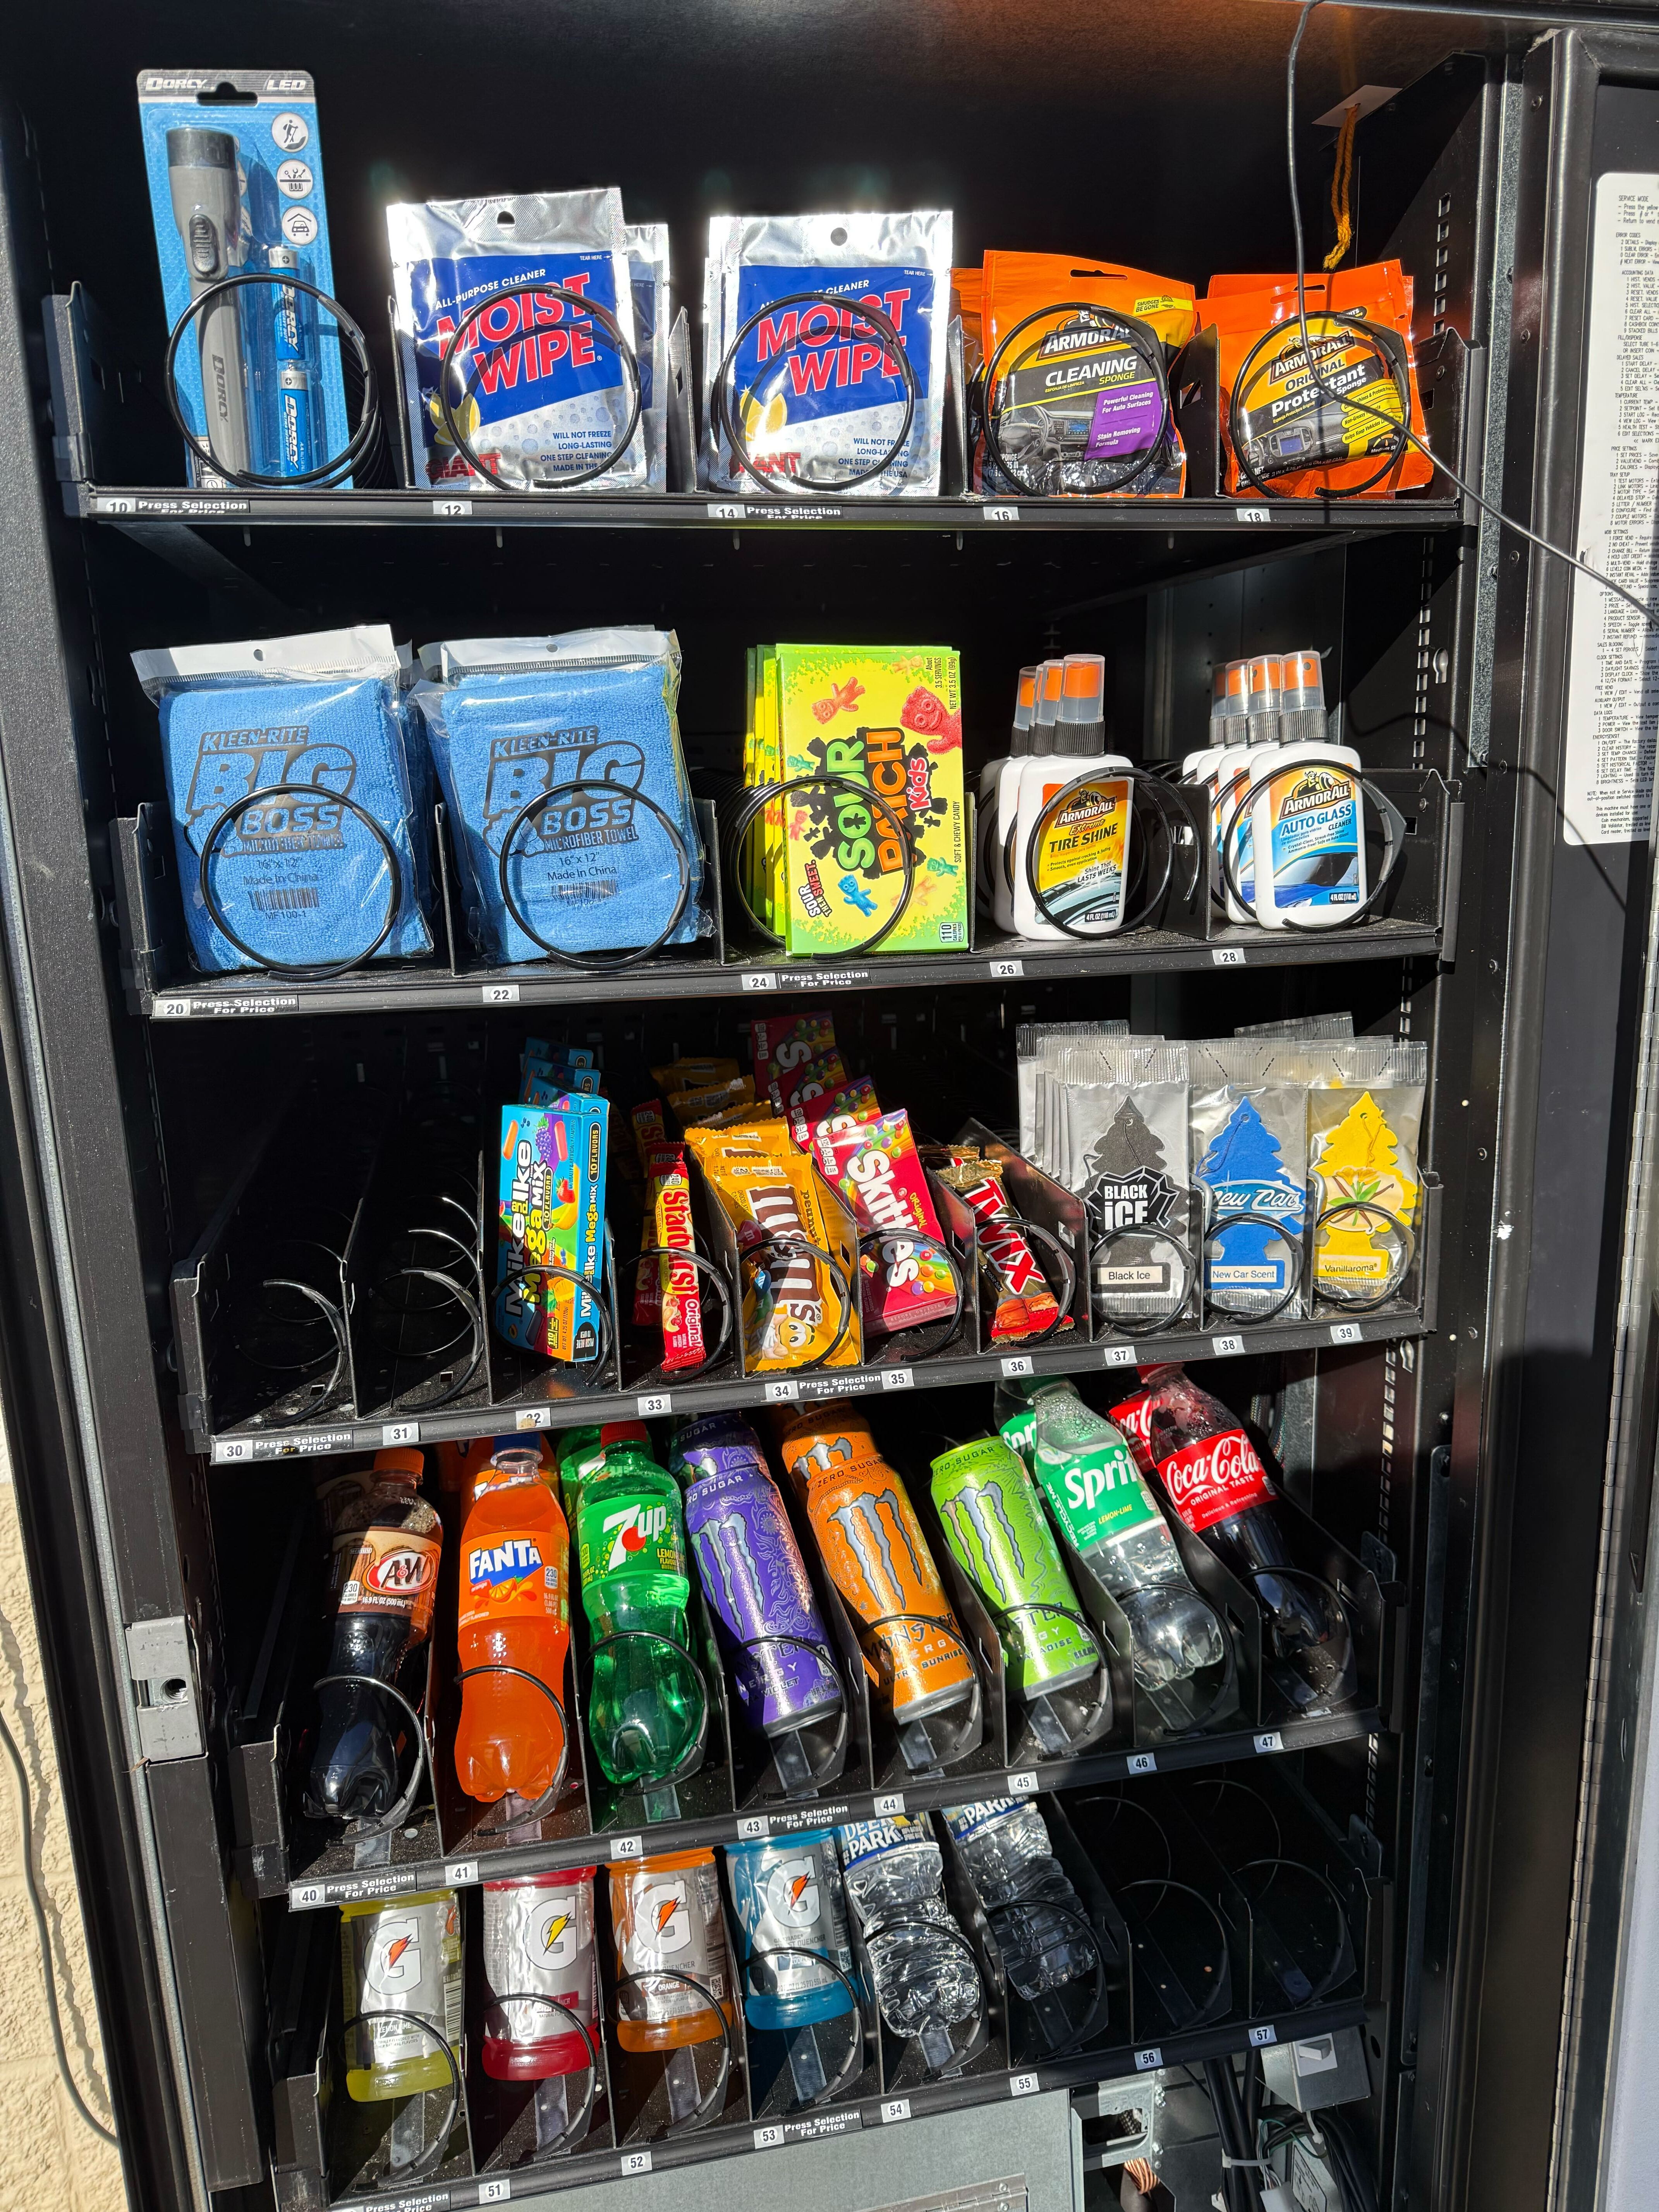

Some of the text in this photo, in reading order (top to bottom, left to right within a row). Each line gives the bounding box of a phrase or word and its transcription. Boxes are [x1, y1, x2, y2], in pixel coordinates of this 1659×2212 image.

[145, 77, 305, 91] DORCY LED
[435, 268, 546, 309] ALL-PURPOSE CLEANER
[1137, 300, 1160, 308] SMUDGES
[1142, 303, 1159, 311] GONE
[436, 272, 590, 361] MOIST
[757, 288, 911, 362] MOIST
[473, 321, 595, 395] WIPE
[1045, 356, 1137, 387] CLEANING
[1099, 371, 1135, 385] SPONGE
[212, 354, 228, 423] DORCY
[1336, 376, 1367, 394] Sponge
[1104, 391, 1153, 405] Powerful Cleaning
[1113, 402, 1126, 410] Auto
[1127, 399, 1151, 409] Surfaces
[285, 394, 299, 472] DORCY
[1097, 427, 1140, 441] Stain Removing
[558, 441, 612, 450] LONG-LASTING
[1096, 439, 1118, 447] Formula
[110, 502, 127, 512] 10
[445, 505, 461, 514] 12
[720, 509, 735, 517] 14
[995, 510, 1009, 520] 16
[1247, 512, 1260, 521] 18
[203, 726, 308, 752] KLEEN-RITE
[495, 727, 598, 757] KLEEN-RITE
[190, 744, 356, 813] BIG
[485, 742, 645, 819] BIG
[907, 757, 930, 811] Kids
[828, 739, 874, 872] SOUR
[240, 805, 341, 836] BOSS
[541, 800, 632, 835] BOSS
[1281, 805, 1352, 836] AUTO GLASS
[1328, 818, 1352, 831] CLEANER
[544, 825, 639, 853] MICROFIBER TOWEL
[1050, 823, 1118, 852] TIRE SHINE
[547, 865, 618, 882] Made In China
[1077, 864, 1116, 883] LASTS WEEKS
[941, 926, 952, 942] 110
[1222, 953, 1236, 962] 28
[1000, 965, 1014, 974] 26
[816, 972, 868, 980] Selection
[752, 978, 767, 988] 24
[494, 990, 509, 1000] 22
[167, 1004, 184, 1014] 20
[589, 1129, 599, 1180] 10 FLAVORS
[672, 1173, 680, 1186] 240
[1104, 1184, 1148, 1199] BLACK
[800, 1190, 820, 1245] peanut
[1109, 1271, 1150, 1280] Black Ice
[1250, 1270, 1275, 1278] Scent
[685, 1298, 701, 1347] Original
[1340, 1328, 1352, 1338] 39
[1222, 1340, 1235, 1350] 38
[1114, 1350, 1127, 1362] 37
[1010, 1361, 1024, 1372] 36
[891, 1373, 905, 1384] 35
[775, 1385, 789, 1397] 34
[648, 1399, 663, 1410] 33
[393, 1429, 409, 1439] 31
[227, 1445, 243, 1457] 30
[955, 1446, 995, 1464] SUGAR
[1167, 1434, 1260, 1505] Coca-Cola
[1190, 1474, 1255, 1505] ORIGINAL TASTE
[1098, 1504, 1133, 1525] LEMON-LIME
[470, 1540, 541, 1578] FANTA
[381, 1555, 429, 1588] A&W
[546, 1568, 557, 1577] 230
[344, 1583, 357, 1592] 230
[922, 1648, 963, 1668] SUNRISE
[1262, 1736, 1273, 1747] 47
[1136, 1757, 1147, 1768] 46
[1017, 1777, 1029, 1788] 45
[883, 1799, 896, 1810] 44
[747, 1822, 759, 1832] 43
[620, 1841, 634, 1853] 42
[454, 1867, 468, 1879] 41
[302, 1890, 317, 1902] 40
[767, 1856, 821, 1927] G
[635, 1881, 691, 1953] G
[524, 1896, 577, 1970] G
[364, 1918, 421, 1996] G
[658, 1982, 680, 1991] ORANGE
[1257, 2029, 1268, 2040] 57
[1142, 2053, 1154, 2064] 56
[1018, 2078, 1031, 2090] 55
[890, 2104, 902, 2115] 54
[785, 2112, 860, 2132] Press Selection
[801, 2122, 845, 2135] For Price
[763, 2130, 775, 2142] 53
[631, 2155, 644, 2167] 52
[488, 2185, 500, 2197] 51
